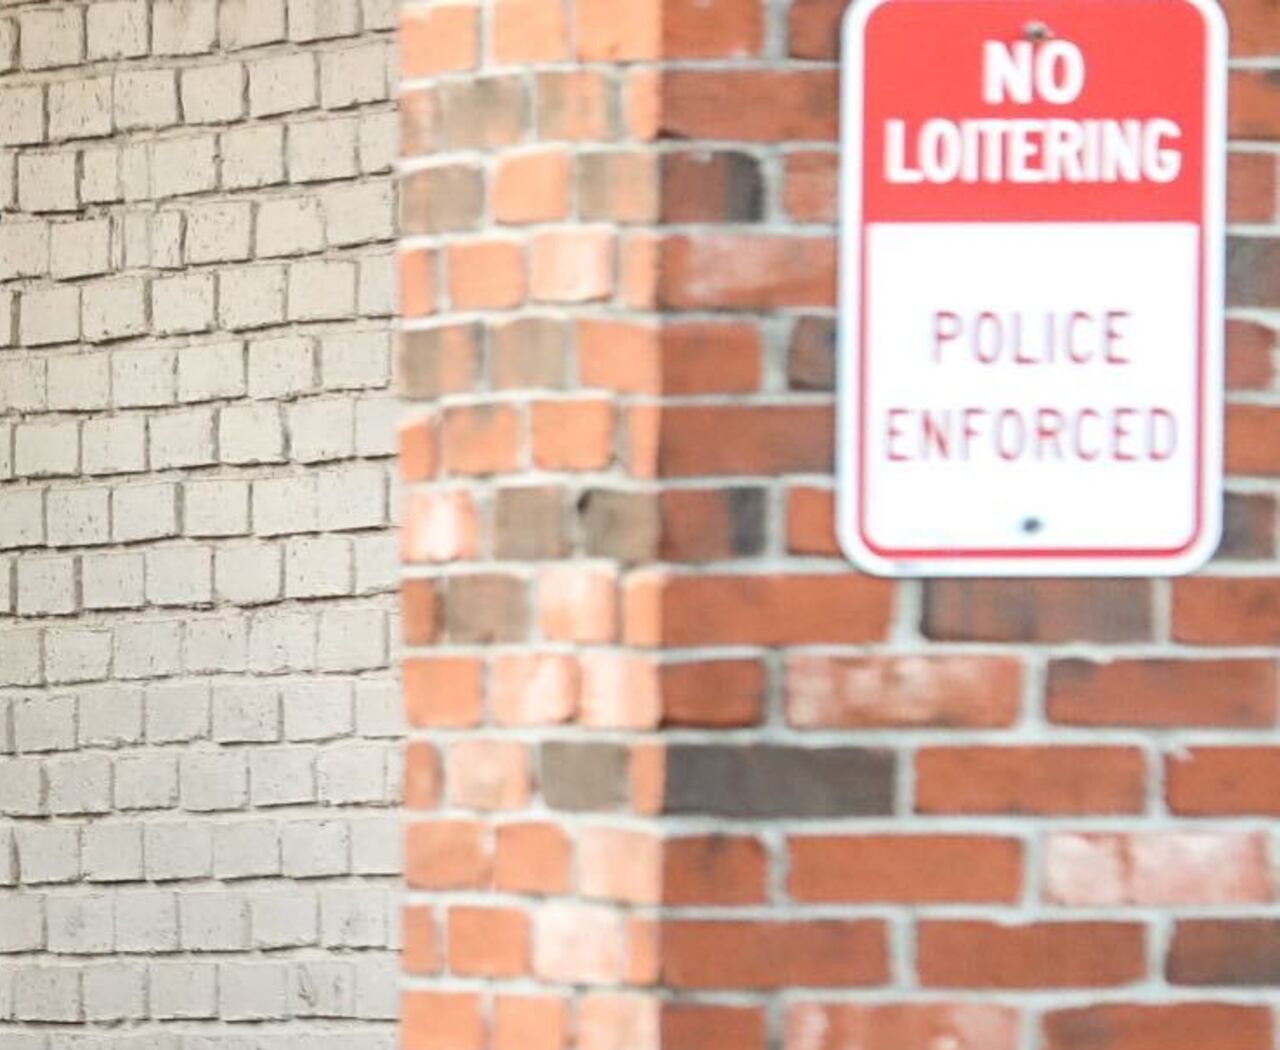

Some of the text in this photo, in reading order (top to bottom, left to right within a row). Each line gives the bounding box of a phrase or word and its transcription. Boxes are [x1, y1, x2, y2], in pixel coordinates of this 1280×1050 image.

[981, 39, 1085, 105] NO
[883, 118, 1182, 184] LOITERING
[931, 310, 1134, 365] POLICE
[883, 408, 1179, 463] ENFORCED
